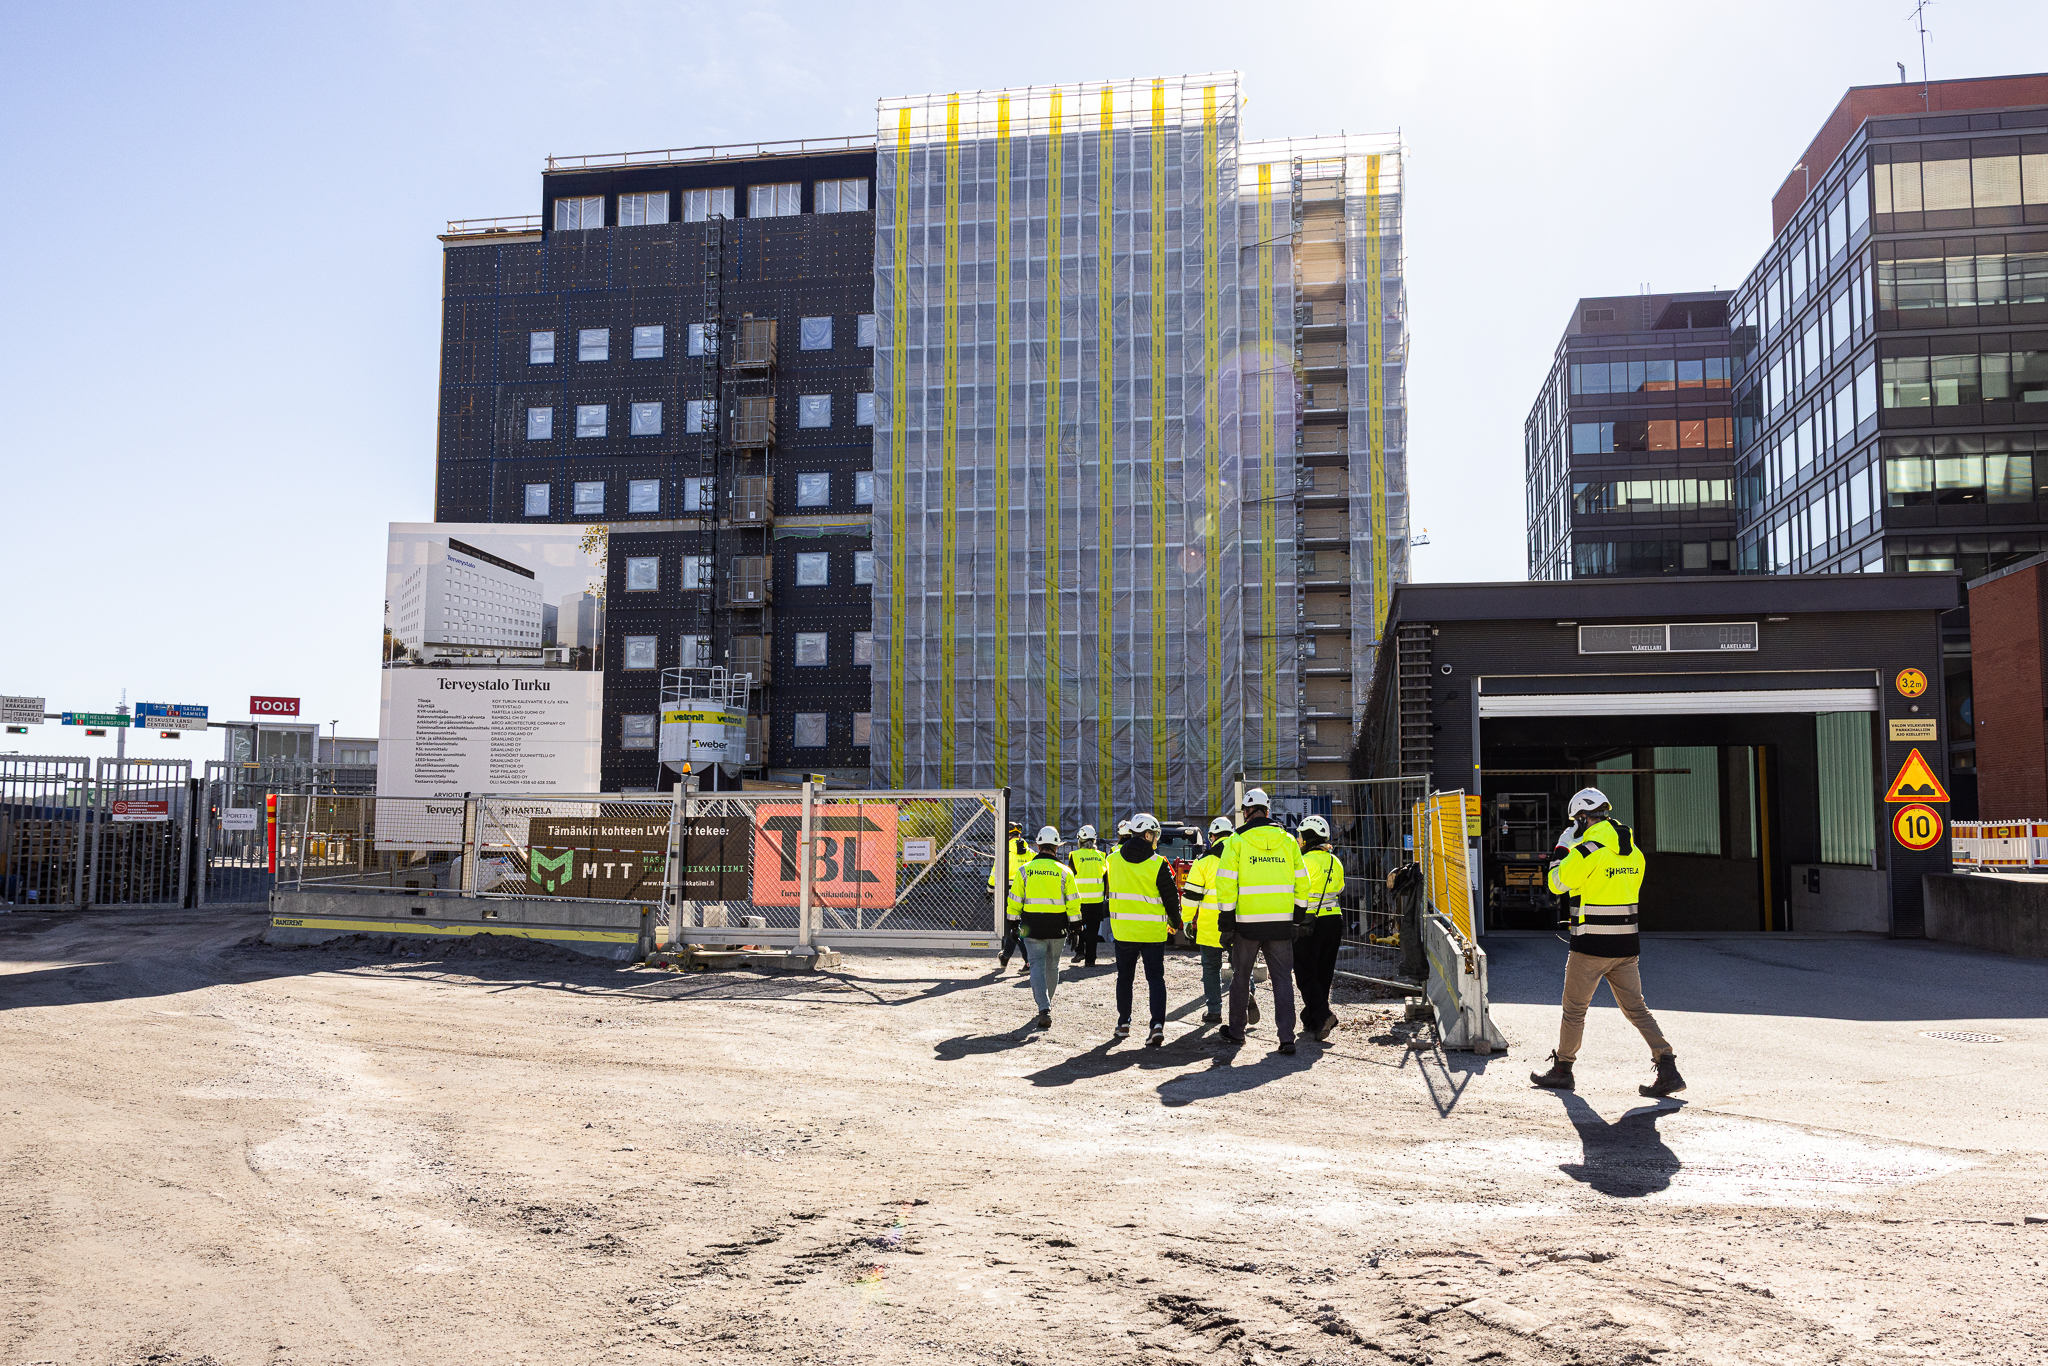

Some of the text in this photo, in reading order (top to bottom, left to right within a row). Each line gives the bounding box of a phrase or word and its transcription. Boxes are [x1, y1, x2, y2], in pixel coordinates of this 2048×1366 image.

[447, 554, 476, 569] Terveystalo
[437, 677, 551, 693] Terveystalo Turku
[255, 701, 296, 713] TOOLS
[699, 739, 729, 749] weber
[425, 804, 463, 817] Terveys
[511, 806, 552, 815] HARTELA
[548, 825, 730, 836] Tämänkin kohteen LVV-öt tekee:
[1905, 815, 1931, 839] 10
[760, 816, 884, 883] TBL
[1257, 856, 1287, 864] HARTELA
[582, 863, 634, 879] MTT
[643, 865, 744, 873] TALONIIKKATIIMI
[1034, 869, 1060, 877] HARTELA
[1615, 867, 1640, 875] HARTELA
